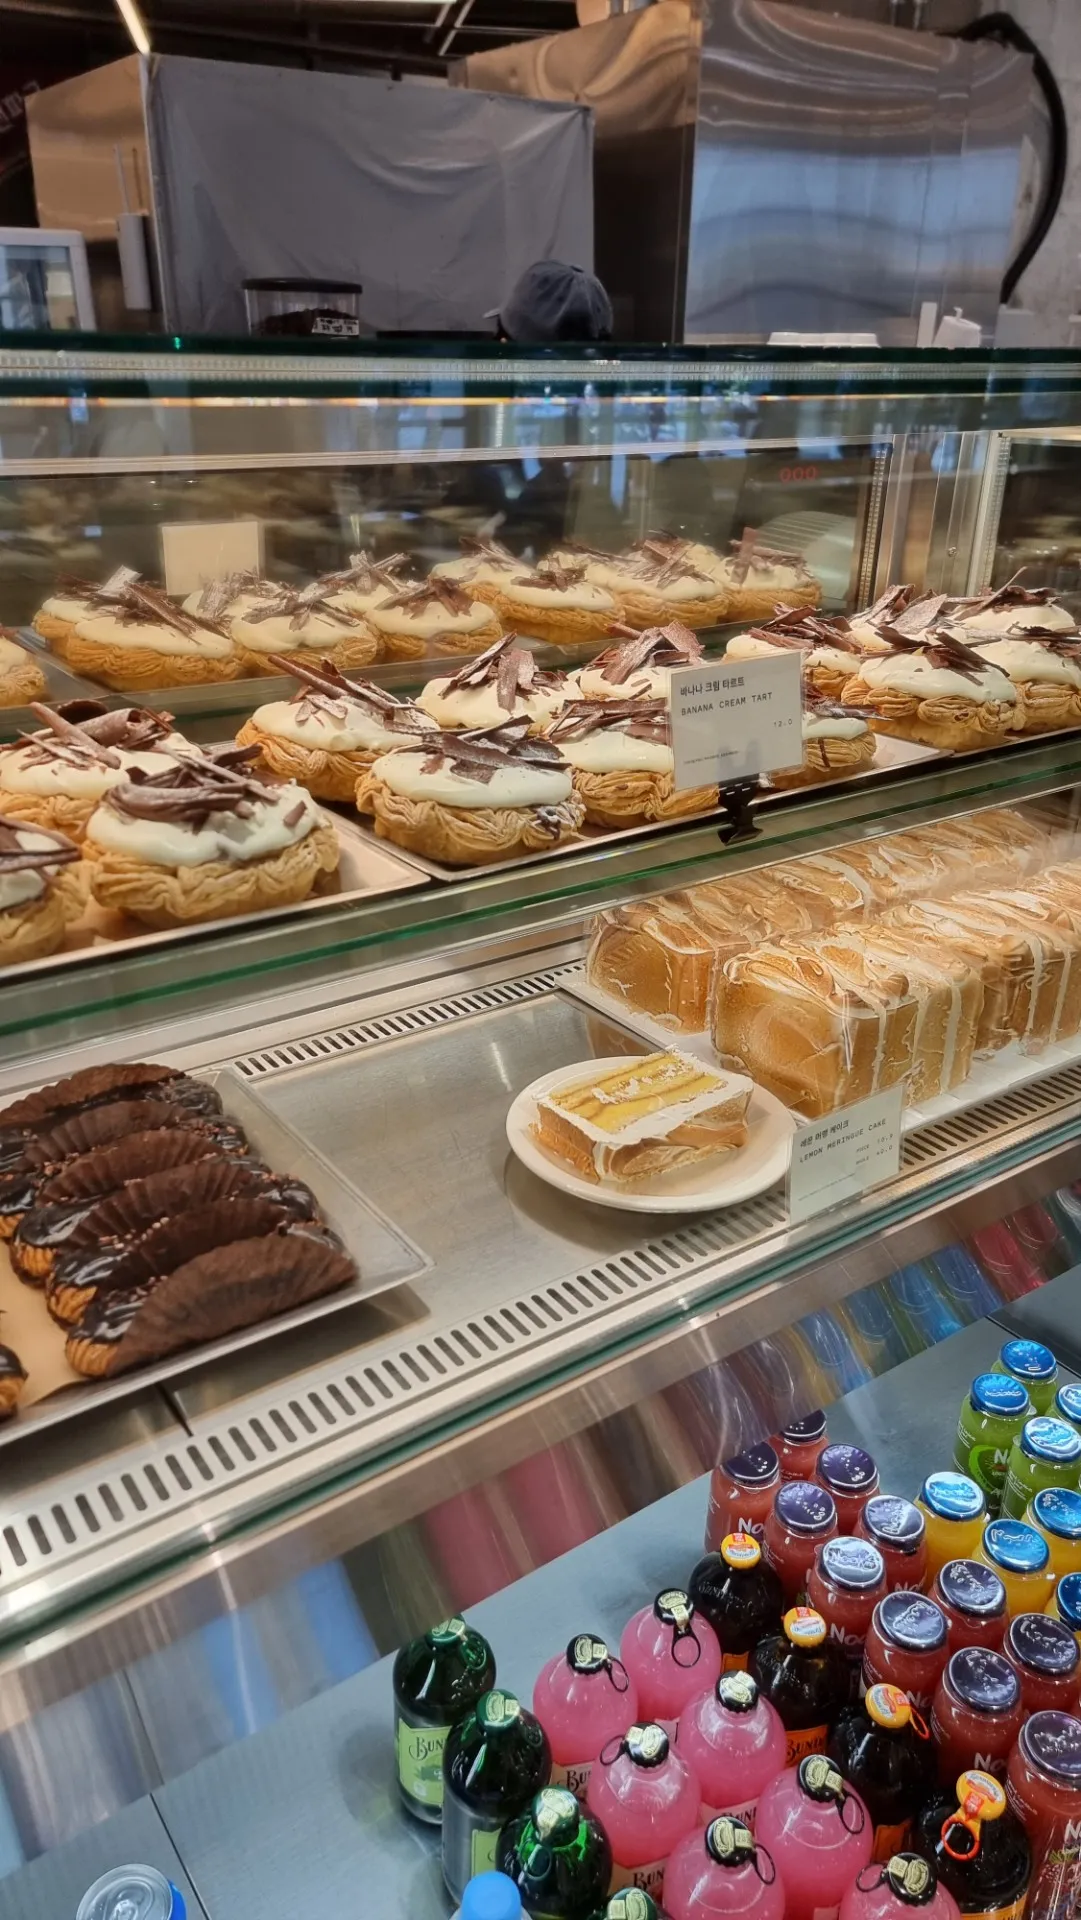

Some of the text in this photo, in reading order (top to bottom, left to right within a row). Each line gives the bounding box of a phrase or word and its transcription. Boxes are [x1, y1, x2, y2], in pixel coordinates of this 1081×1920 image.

[680, 676, 745, 697] 바나나 크림 타르트
[681, 692, 773, 716] BANANA CREAM TART
[799, 1118, 887, 1163] LEMON MERINGUE CAKE
